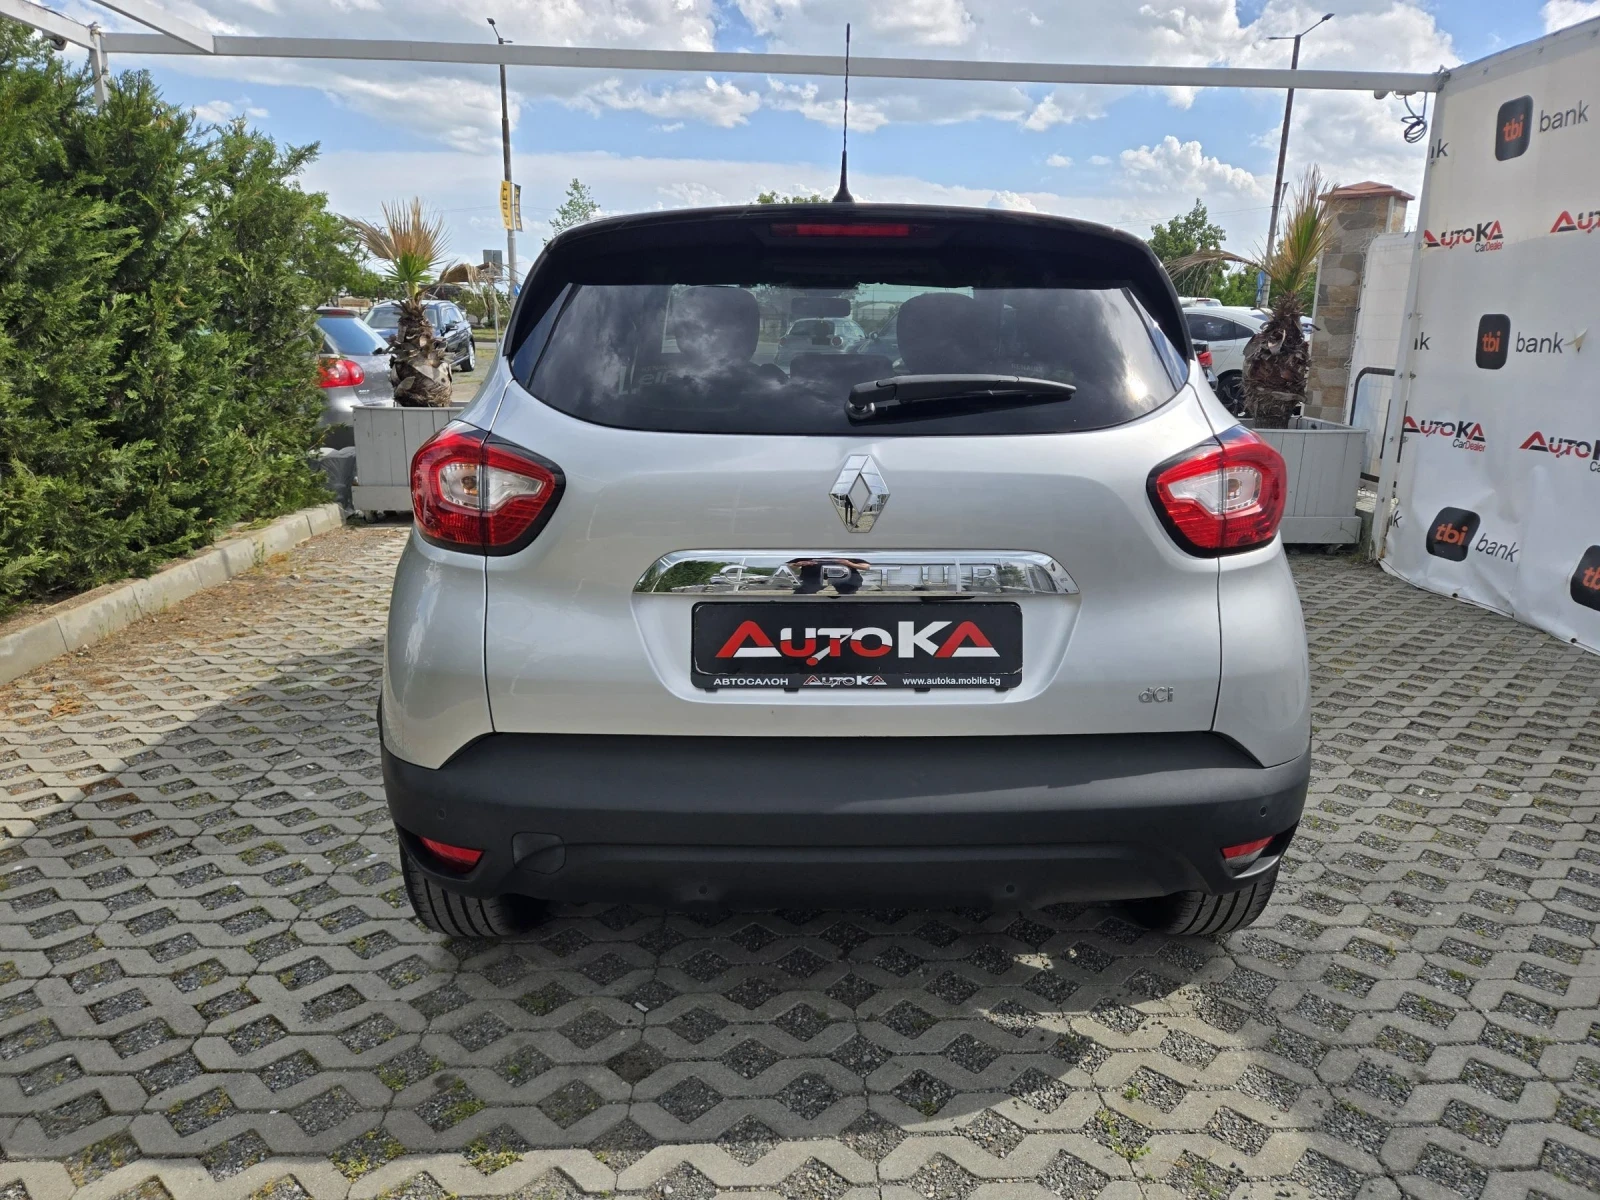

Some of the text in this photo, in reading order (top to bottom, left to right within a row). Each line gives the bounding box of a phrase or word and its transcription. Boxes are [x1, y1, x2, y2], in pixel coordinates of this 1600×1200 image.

[1503, 100, 1589, 142] tbi bank
[1482, 330, 1564, 353] tbi bank
[1436, 523, 1520, 562] tbi bank
[718, 564, 1001, 587] CAPTUR
[713, 678, 789, 686] АВТОСАЛОН
[902, 676, 1001, 687] www.autoka.mobile.bg
[1138, 686, 1174, 703] dCi
